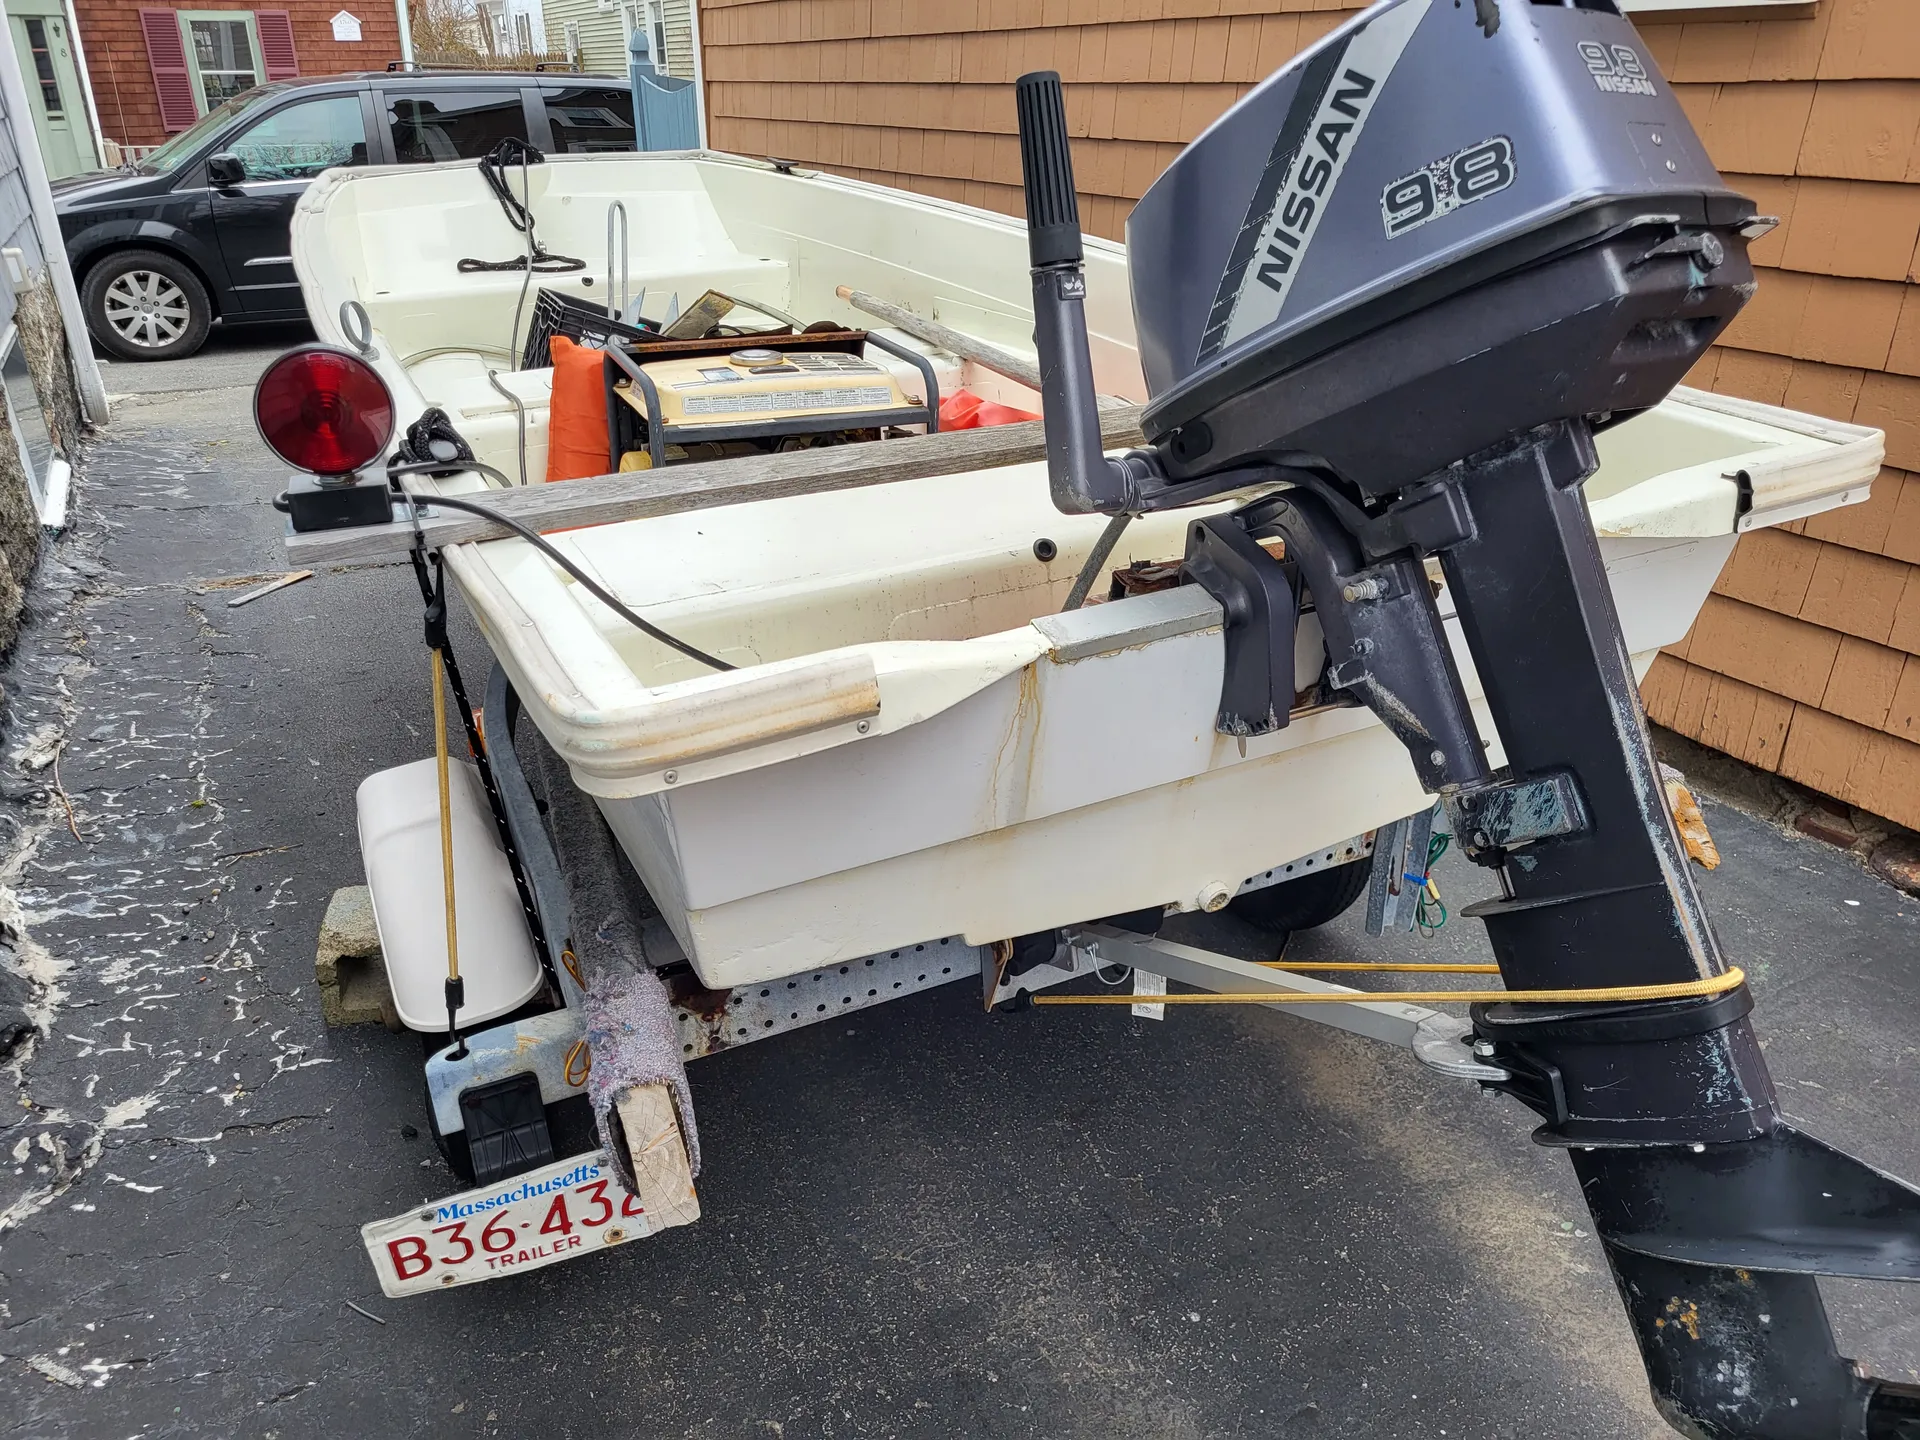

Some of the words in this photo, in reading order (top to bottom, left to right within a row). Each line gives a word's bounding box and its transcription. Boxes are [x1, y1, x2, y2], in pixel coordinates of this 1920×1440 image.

[61, 48, 67, 57] 8
[1577, 41, 1647, 80] 9.8
[1594, 75, 1657, 96] NISSAN
[1257, 68, 1376, 293] NISSAN
[1383, 137, 1515, 238] 9.8
[437, 1163, 600, 1223] Massachusetts
[485, 1235, 583, 1269] TRAILER
